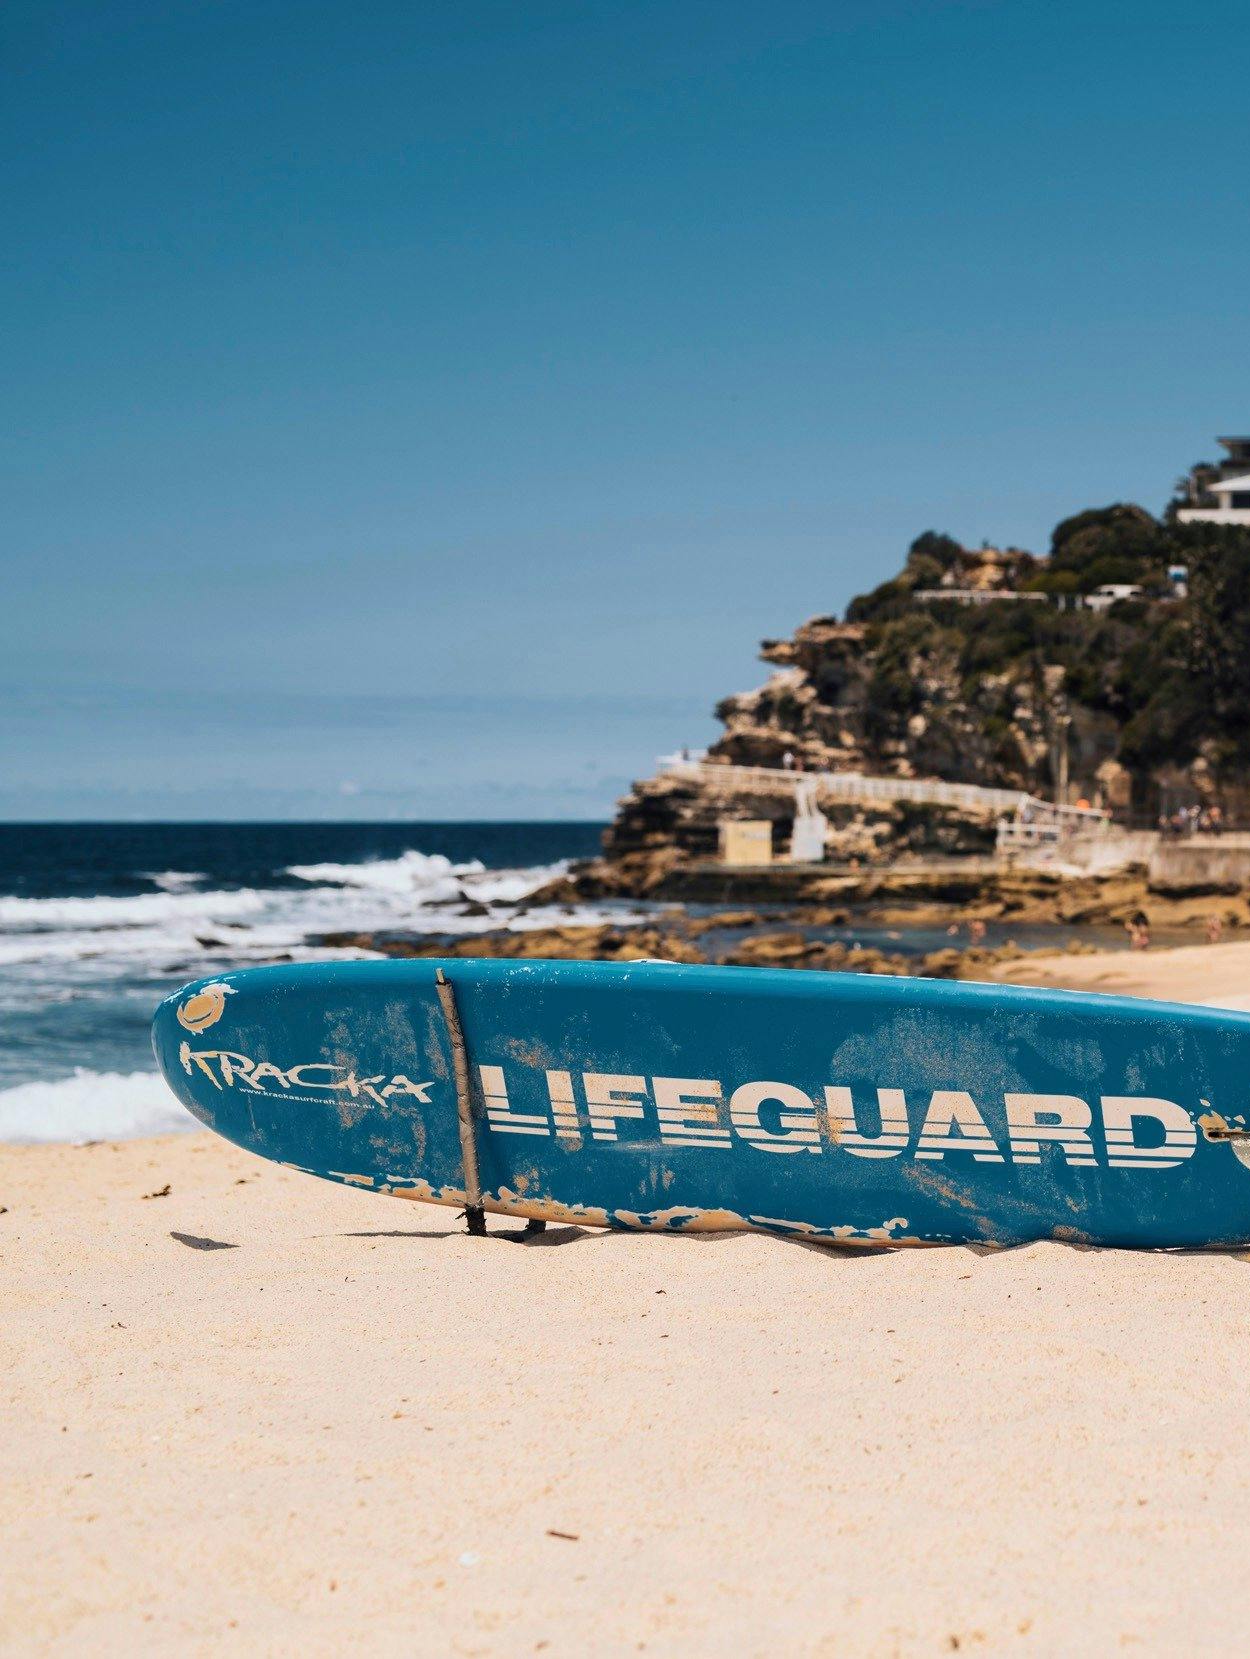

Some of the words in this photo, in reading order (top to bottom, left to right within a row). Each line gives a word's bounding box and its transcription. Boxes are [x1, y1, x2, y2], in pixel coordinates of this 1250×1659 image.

[179, 1041, 435, 1107] KRACKA
[238, 1086, 375, 1109] www.krackasurfcraft.com.au
[479, 1065, 1198, 1169] LIFEGUARD
